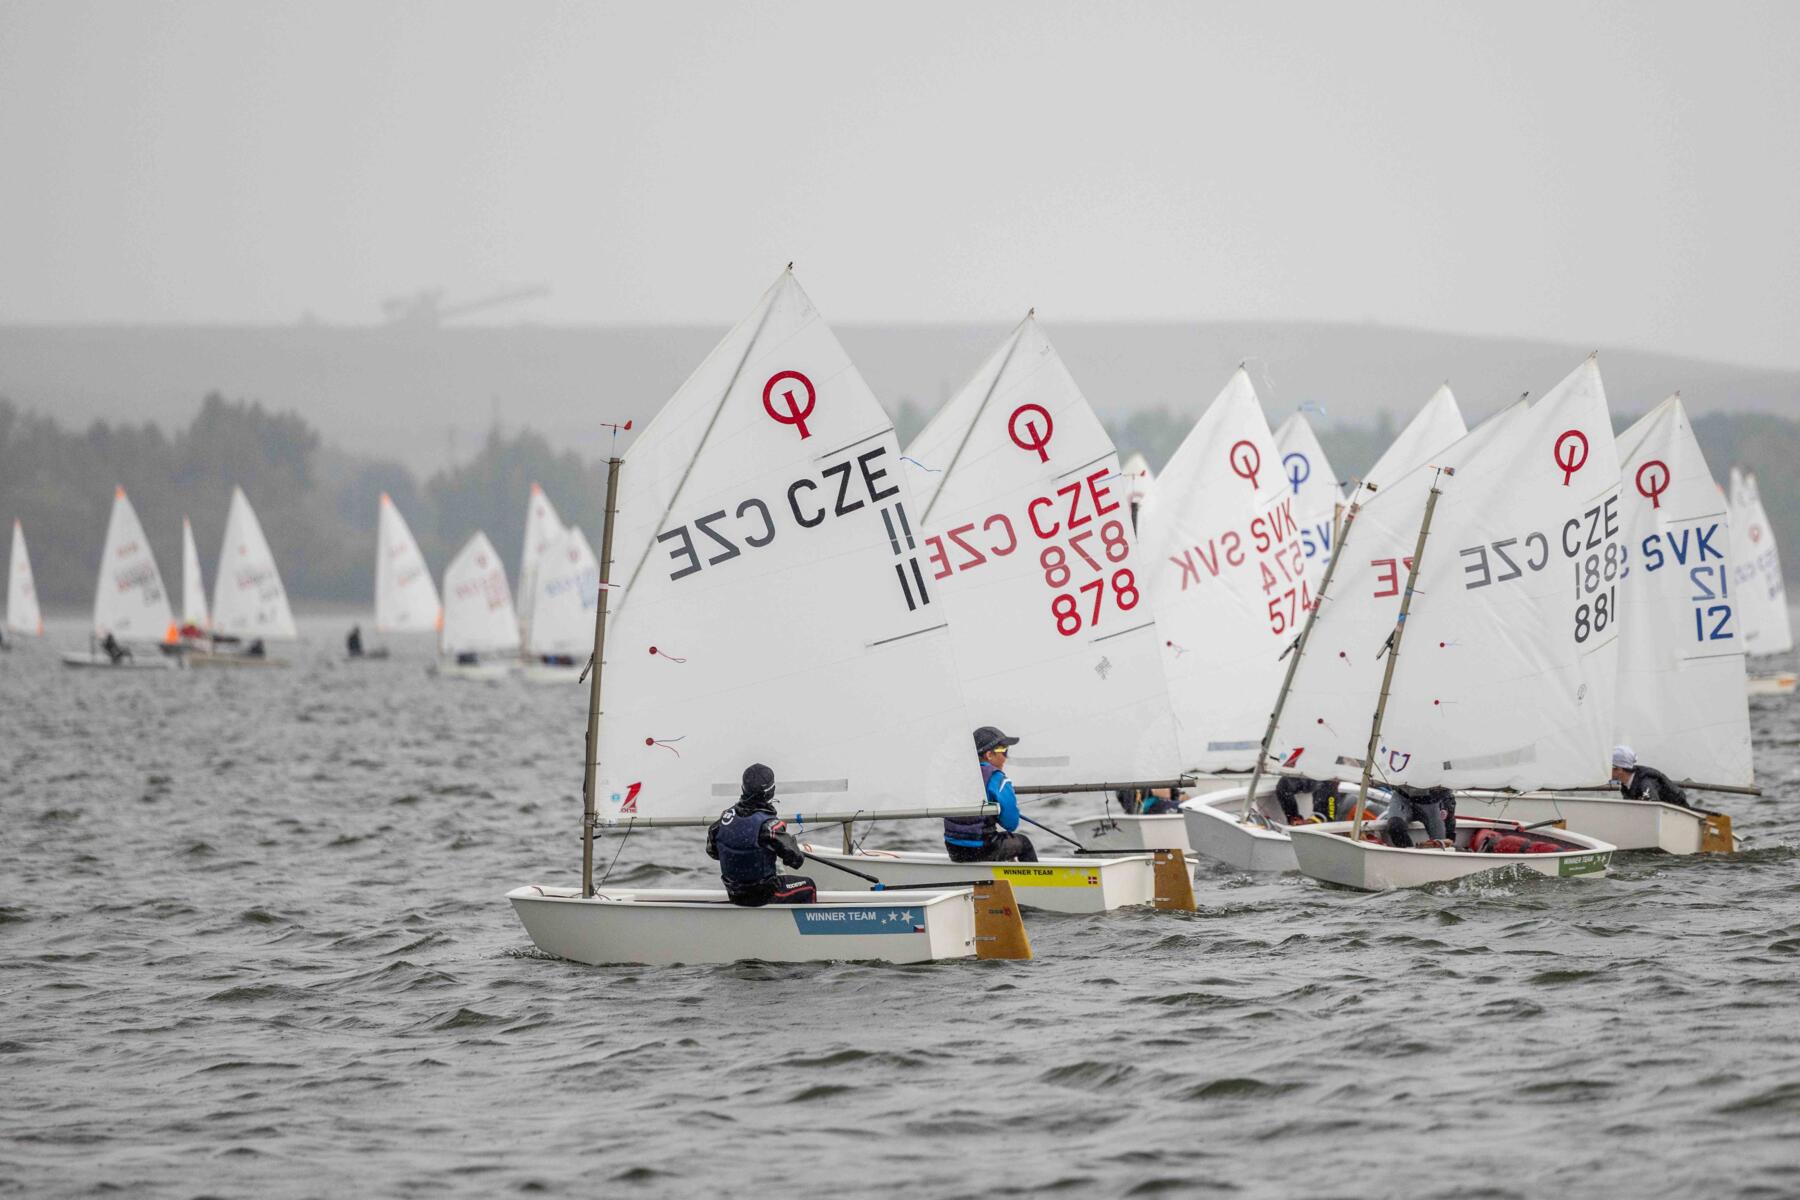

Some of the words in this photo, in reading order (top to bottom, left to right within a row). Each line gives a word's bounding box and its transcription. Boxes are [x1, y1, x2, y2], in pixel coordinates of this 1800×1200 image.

[787, 446, 900, 528] CZE
[1027, 467, 1120, 539] CZE
[1250, 497, 1298, 553] SVK
[1562, 494, 1619, 558] CZE
[1642, 524, 1724, 572] SVK
[895, 557, 931, 612] 11
[1051, 568, 1140, 637] 878
[1268, 580, 1313, 636] 574
[1574, 585, 1616, 644] 881
[1695, 605, 1734, 642] 12
[805, 911, 846, 921] WINNER
[849, 911, 877, 921] TEAM
